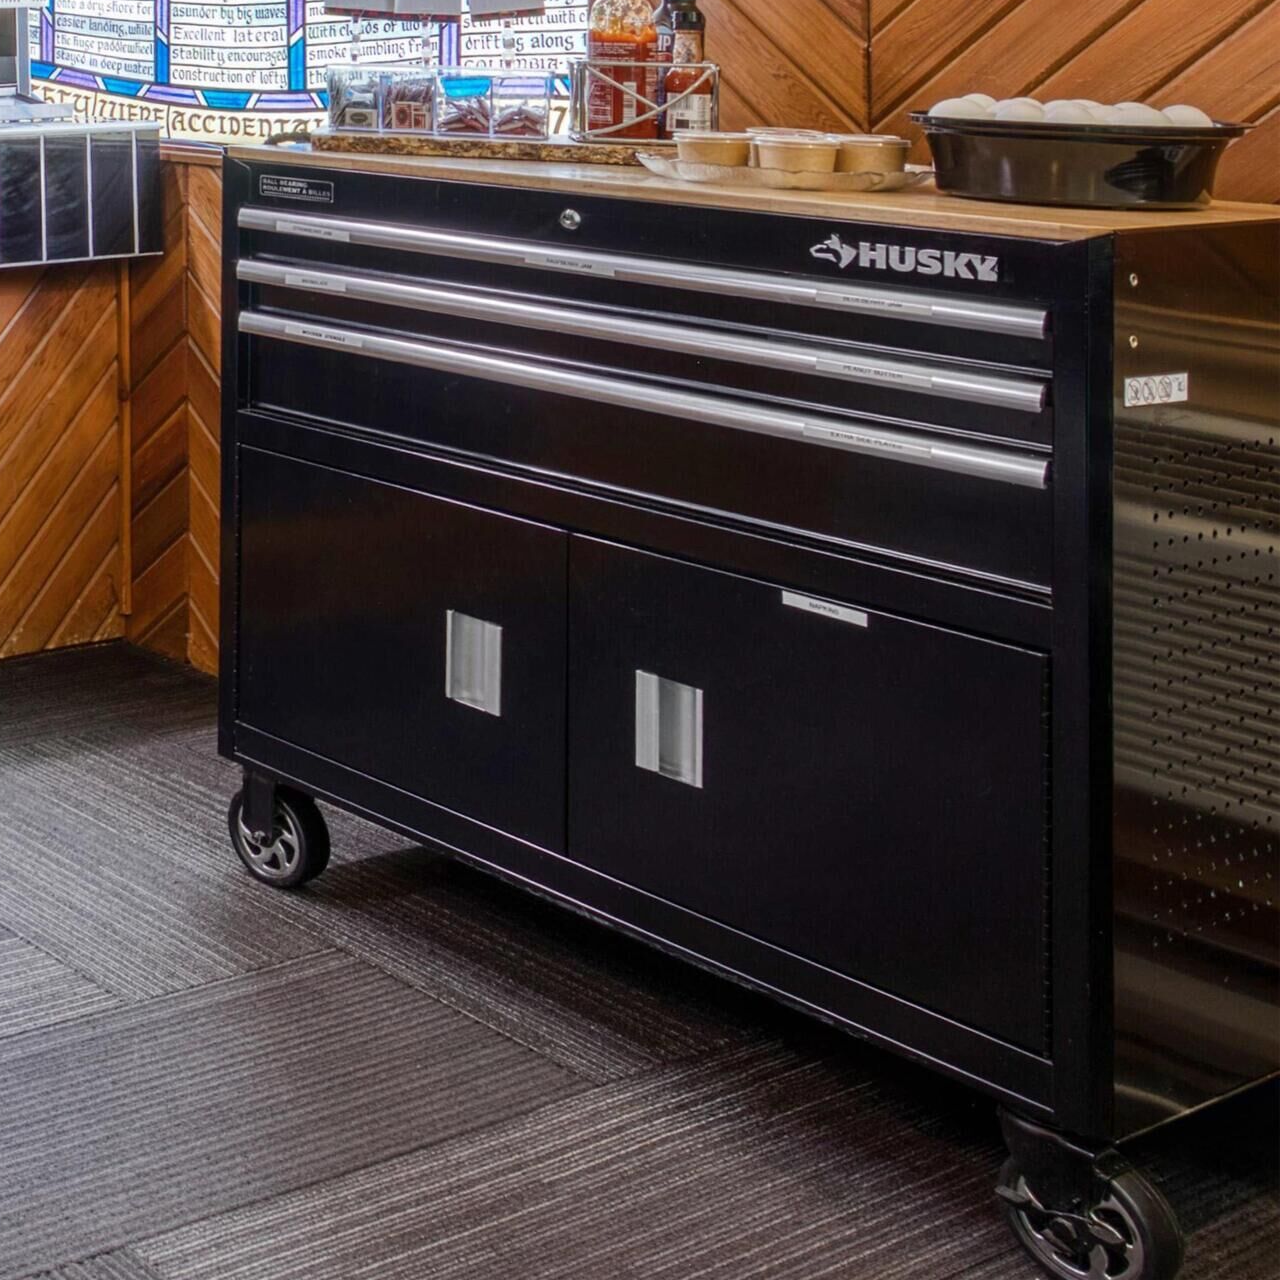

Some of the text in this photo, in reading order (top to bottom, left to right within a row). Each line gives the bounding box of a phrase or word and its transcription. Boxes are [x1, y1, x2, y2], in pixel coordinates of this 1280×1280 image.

[172, 6, 253, 25] asunder by big
[172, 26, 285, 43] Excellent lateral
[308, 24, 338, 40] With
[531, 33, 575, 51] along
[171, 47, 288, 66] stability encouraged
[308, 46, 348, 62] smoke
[171, 67, 288, 89] construction of lofty
[279, 179, 309, 188] BEARING
[858, 241, 999, 283] HUSKY
[842, 364, 871, 374] PEANUT
